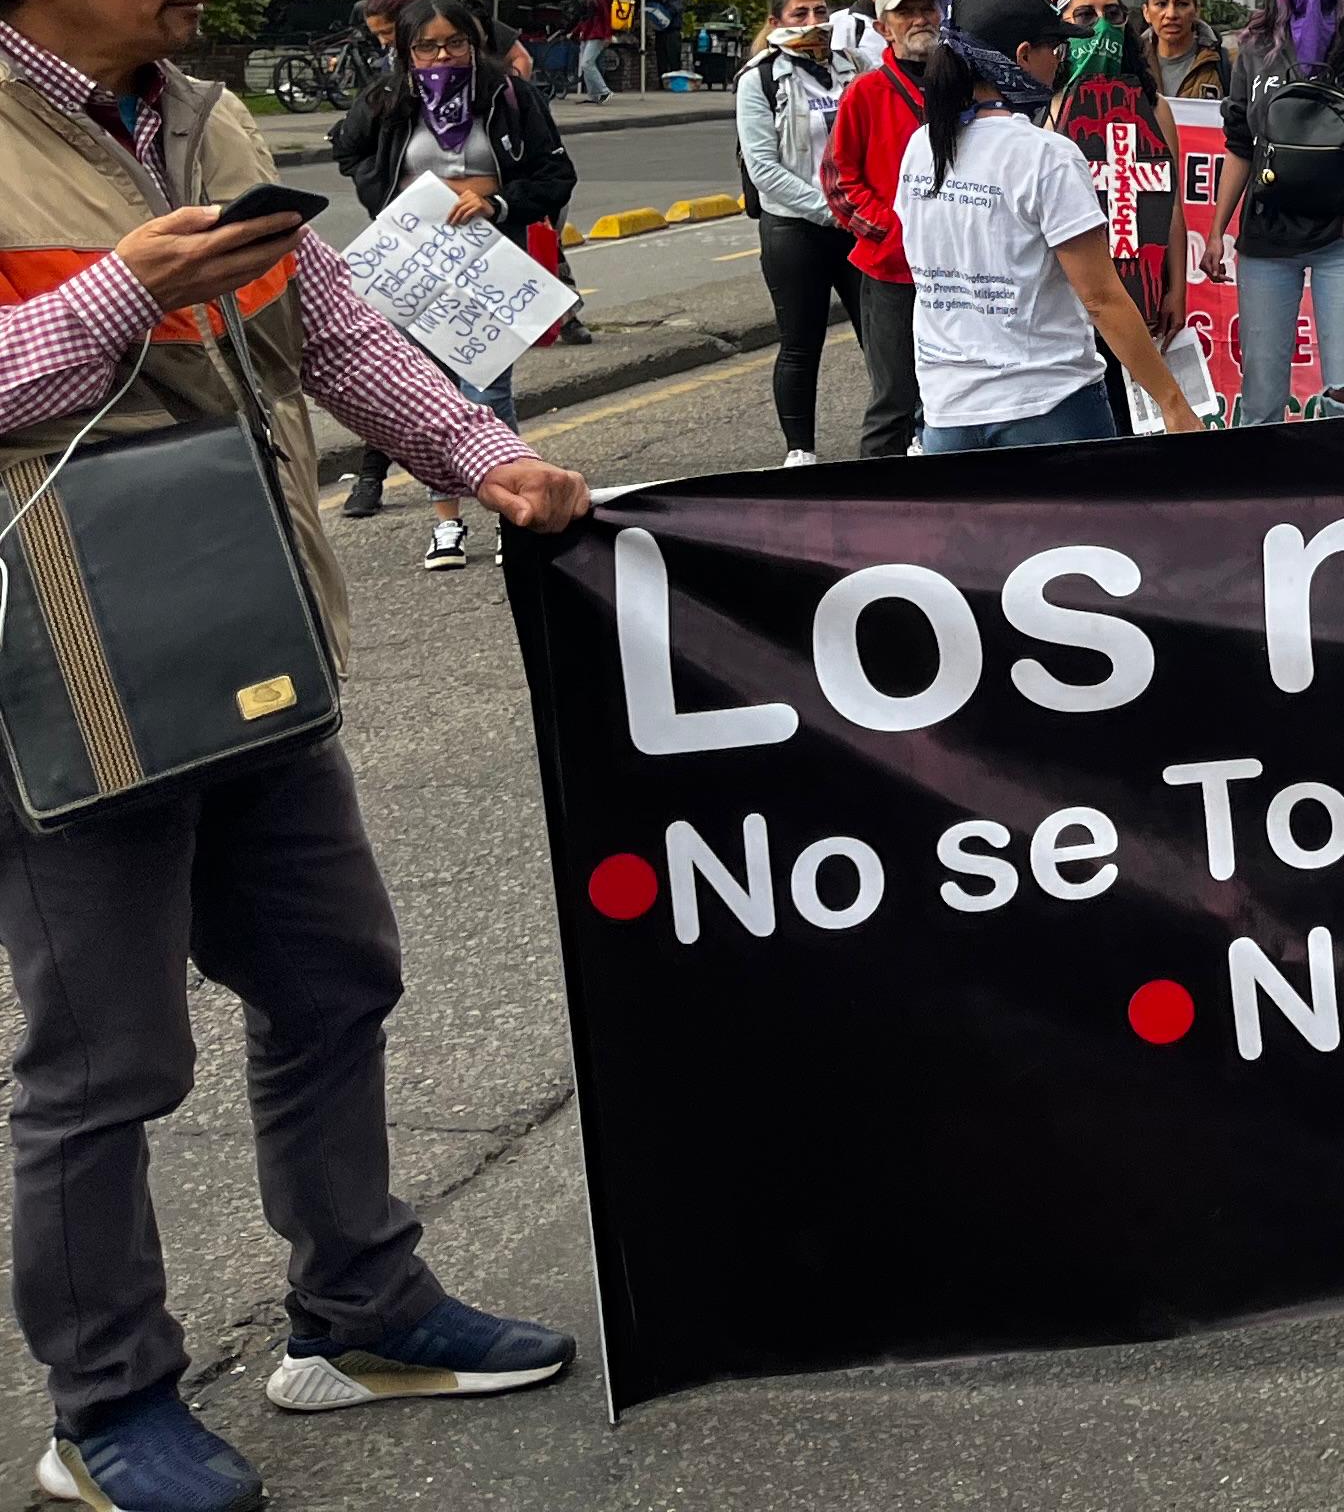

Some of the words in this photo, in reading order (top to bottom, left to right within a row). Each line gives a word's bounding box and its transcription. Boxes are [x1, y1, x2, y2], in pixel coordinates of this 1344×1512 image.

[945, 179, 1002, 196] CICATRICES
[481, 324, 501, 341] a
[615, 527, 1154, 755] Los
[666, 813, 885, 945] No
[937, 807, 1119, 913] se
